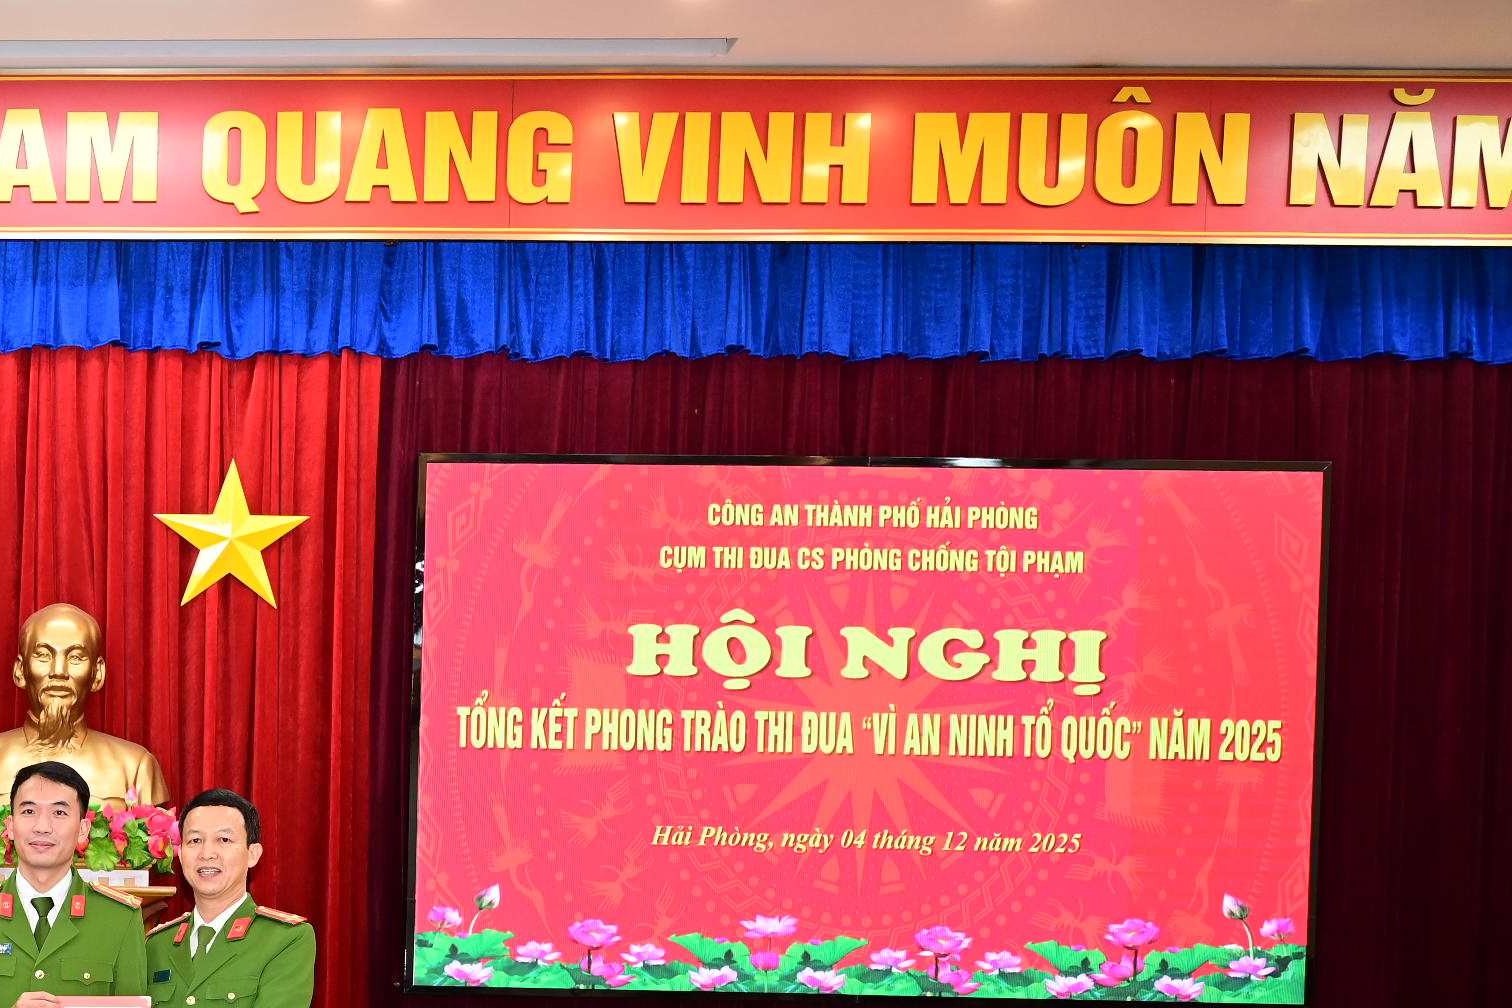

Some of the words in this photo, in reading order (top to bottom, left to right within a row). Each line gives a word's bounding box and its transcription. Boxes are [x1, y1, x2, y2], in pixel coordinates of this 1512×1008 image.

[201, 107, 574, 214] QUANG
[612, 111, 873, 205] VINH
[910, 86, 1251, 207] MUÔN
[1288, 87, 1512, 209] NĂM
[707, 499, 764, 527] CÔNG
[770, 504, 799, 527] AN
[804, 500, 873, 528] THÀNH
[878, 498, 921, 529] PHỐ
[926, 496, 962, 529] HẢI
[967, 501, 1039, 530] PHÒNG
[659, 546, 707, 573] CỤM
[713, 546, 745, 570] THI
[749, 546, 792, 570] ĐUA
[797, 547, 825, 571] CS
[831, 544, 903, 571] PHÒNG
[907, 541, 979, 573] CHỐNG
[984, 545, 1017, 578] TỘI
[1022, 550, 1085, 578] PHẠM
[626, 608, 813, 690] HỘI
[840, 626, 1108, 696] NGHỊ
[456, 689, 523, 750] TỔNG
[530, 692, 578, 751] KẾT
[584, 708, 674, 753] PHONG
[680, 701, 747, 754] TRÀO
[754, 710, 795, 754] THI
[800, 711, 855, 755] ĐUA
[903, 713, 941, 757] AN
[948, 714, 1014, 758] NINH
[1021, 698, 1055, 759] TỔ
[1148, 708, 1211, 761] NĂM
[1217, 718, 1283, 763] 2025
[650, 825, 693, 847] Hải
[698, 826, 775, 851] Phòng,
[781, 831, 834, 854] ngày
[839, 829, 866, 849] 04
[872, 830, 936, 857] tháng
[941, 831, 969, 852] 12
[974, 835, 1024, 853] năm
[1029, 833, 1083, 854] 2025
